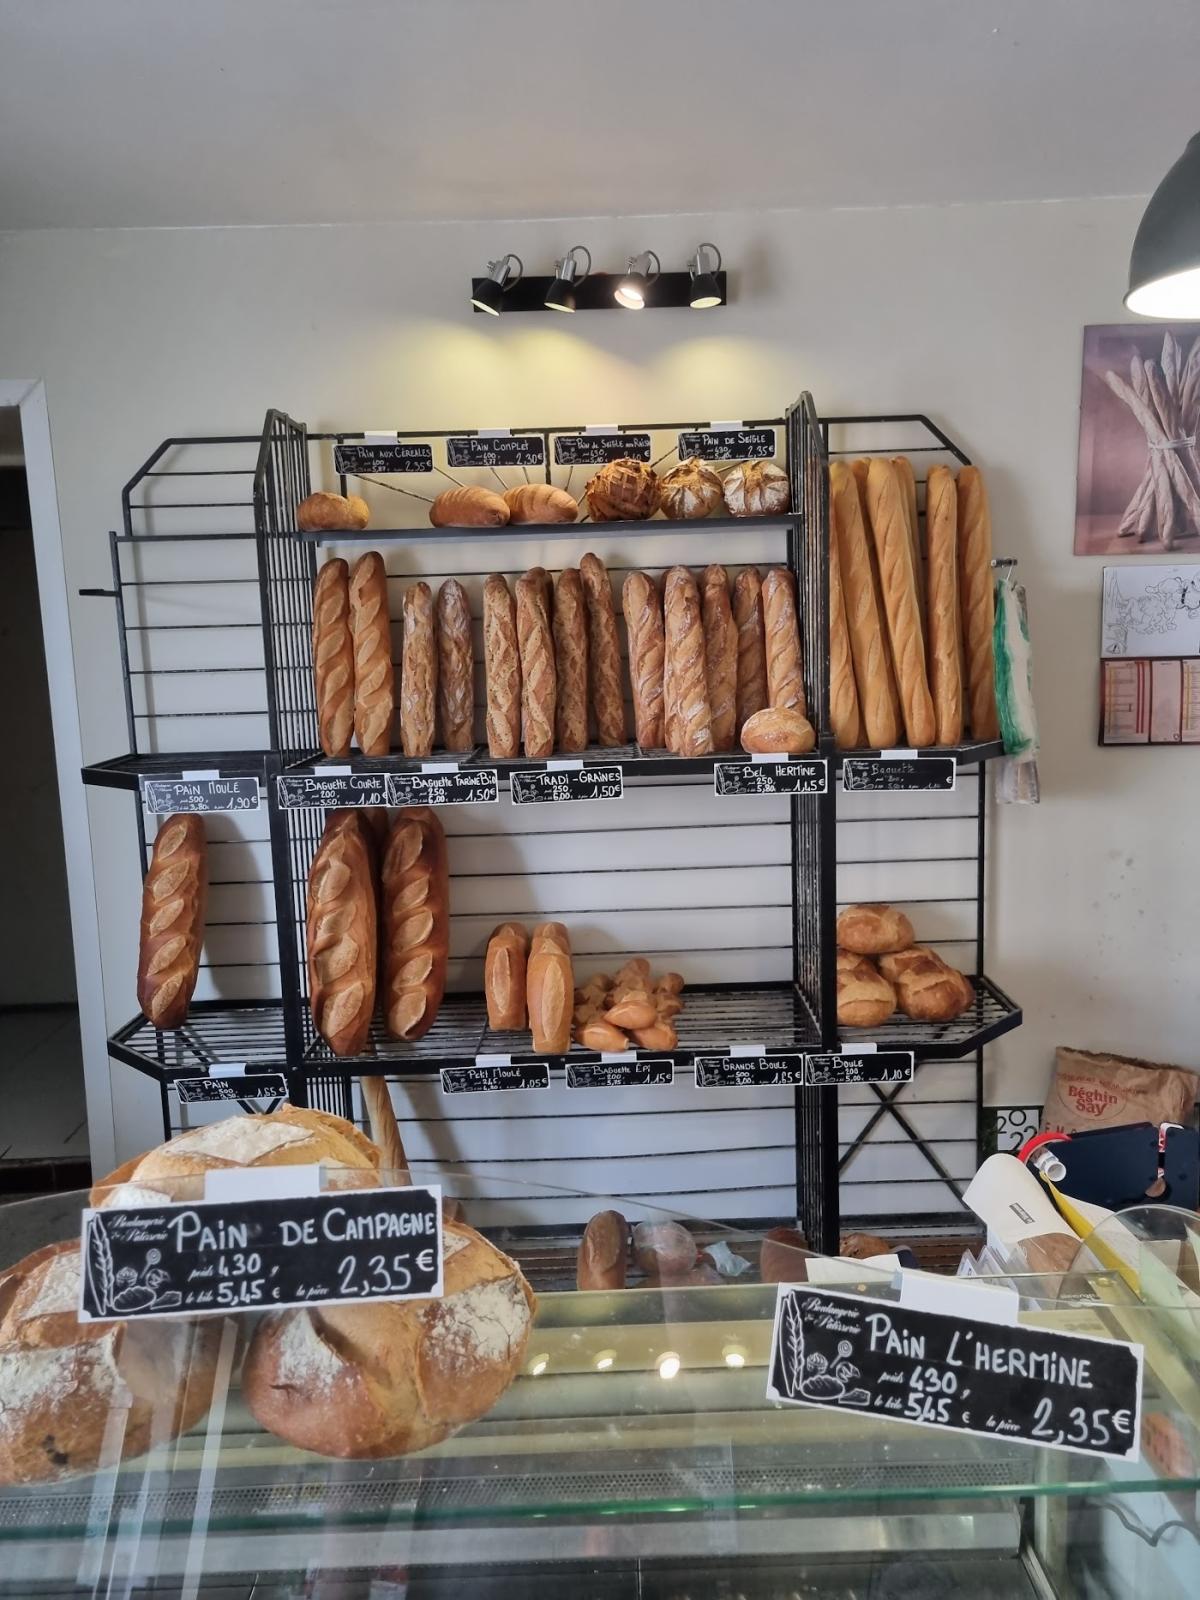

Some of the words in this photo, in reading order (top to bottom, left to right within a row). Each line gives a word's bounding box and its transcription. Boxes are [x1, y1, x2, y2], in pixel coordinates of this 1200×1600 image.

[1069, 1086, 1117, 1104] Béghin
[1076, 1099, 1107, 1116] Say
[279, 1218, 318, 1246] DE
[322, 1207, 435, 1241] CAMPAGNE
[218, 1253, 261, 1277] 430
[802, 1297, 860, 1318] Boulangerie
[909, 1366, 958, 1394] 430
